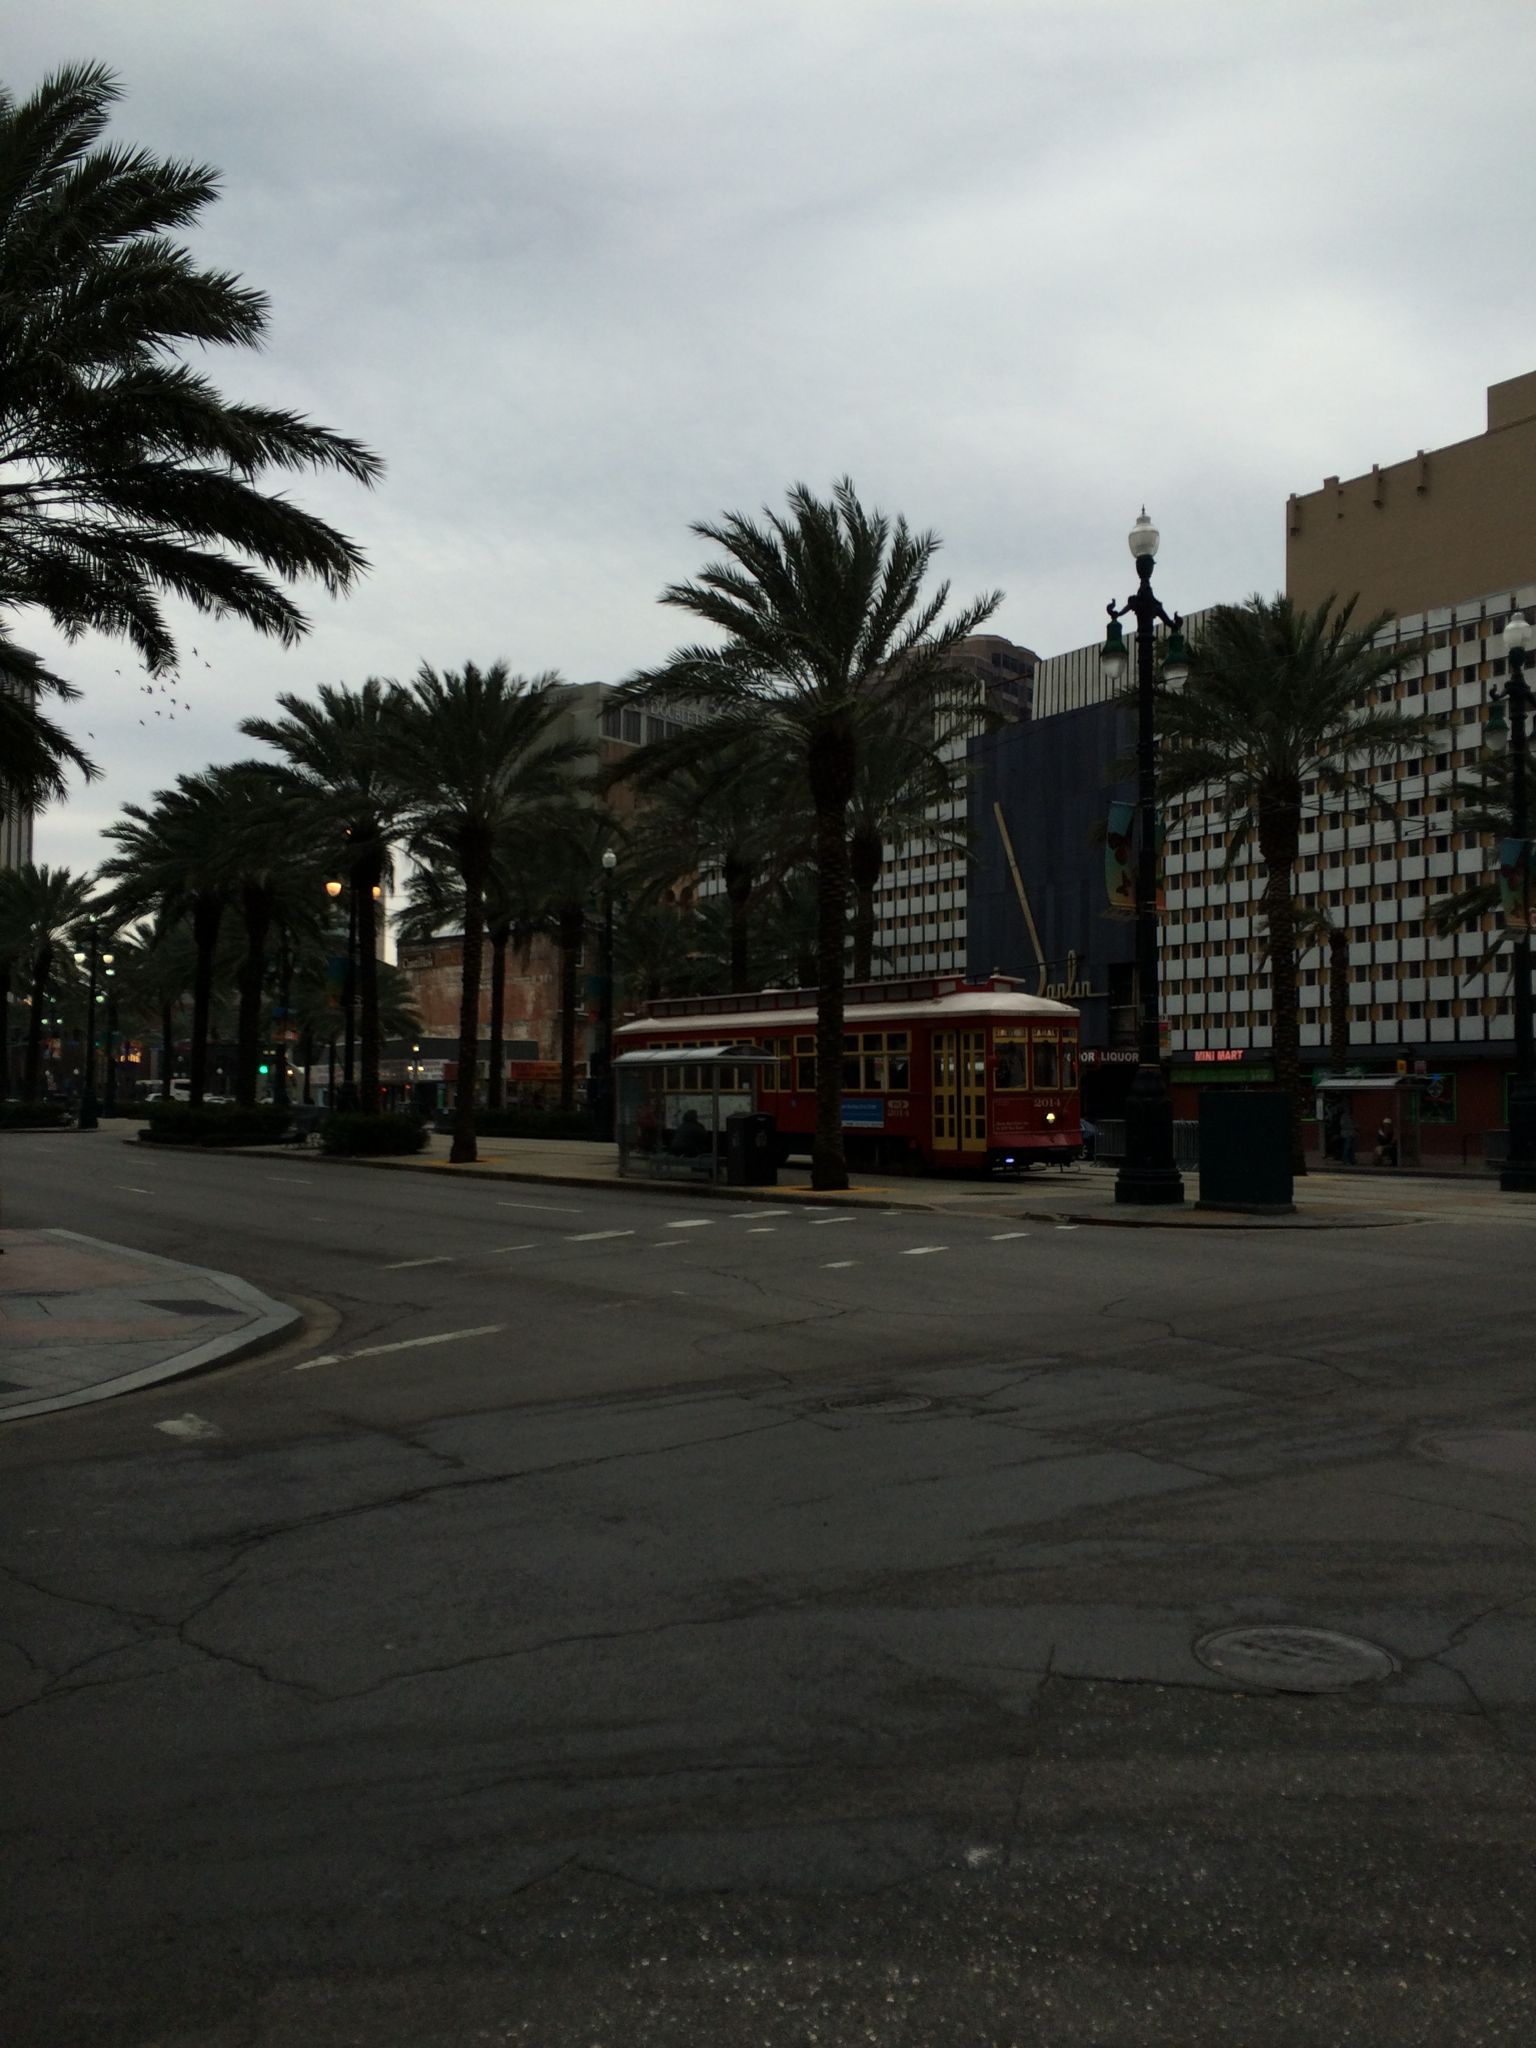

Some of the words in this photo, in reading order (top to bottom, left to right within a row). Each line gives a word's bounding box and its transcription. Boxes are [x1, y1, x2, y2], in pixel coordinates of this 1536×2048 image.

[1101, 1051, 1140, 1063] LIQUOR
[1194, 1050, 1215, 1062] MINI
[1217, 1049, 1244, 1061] MART
